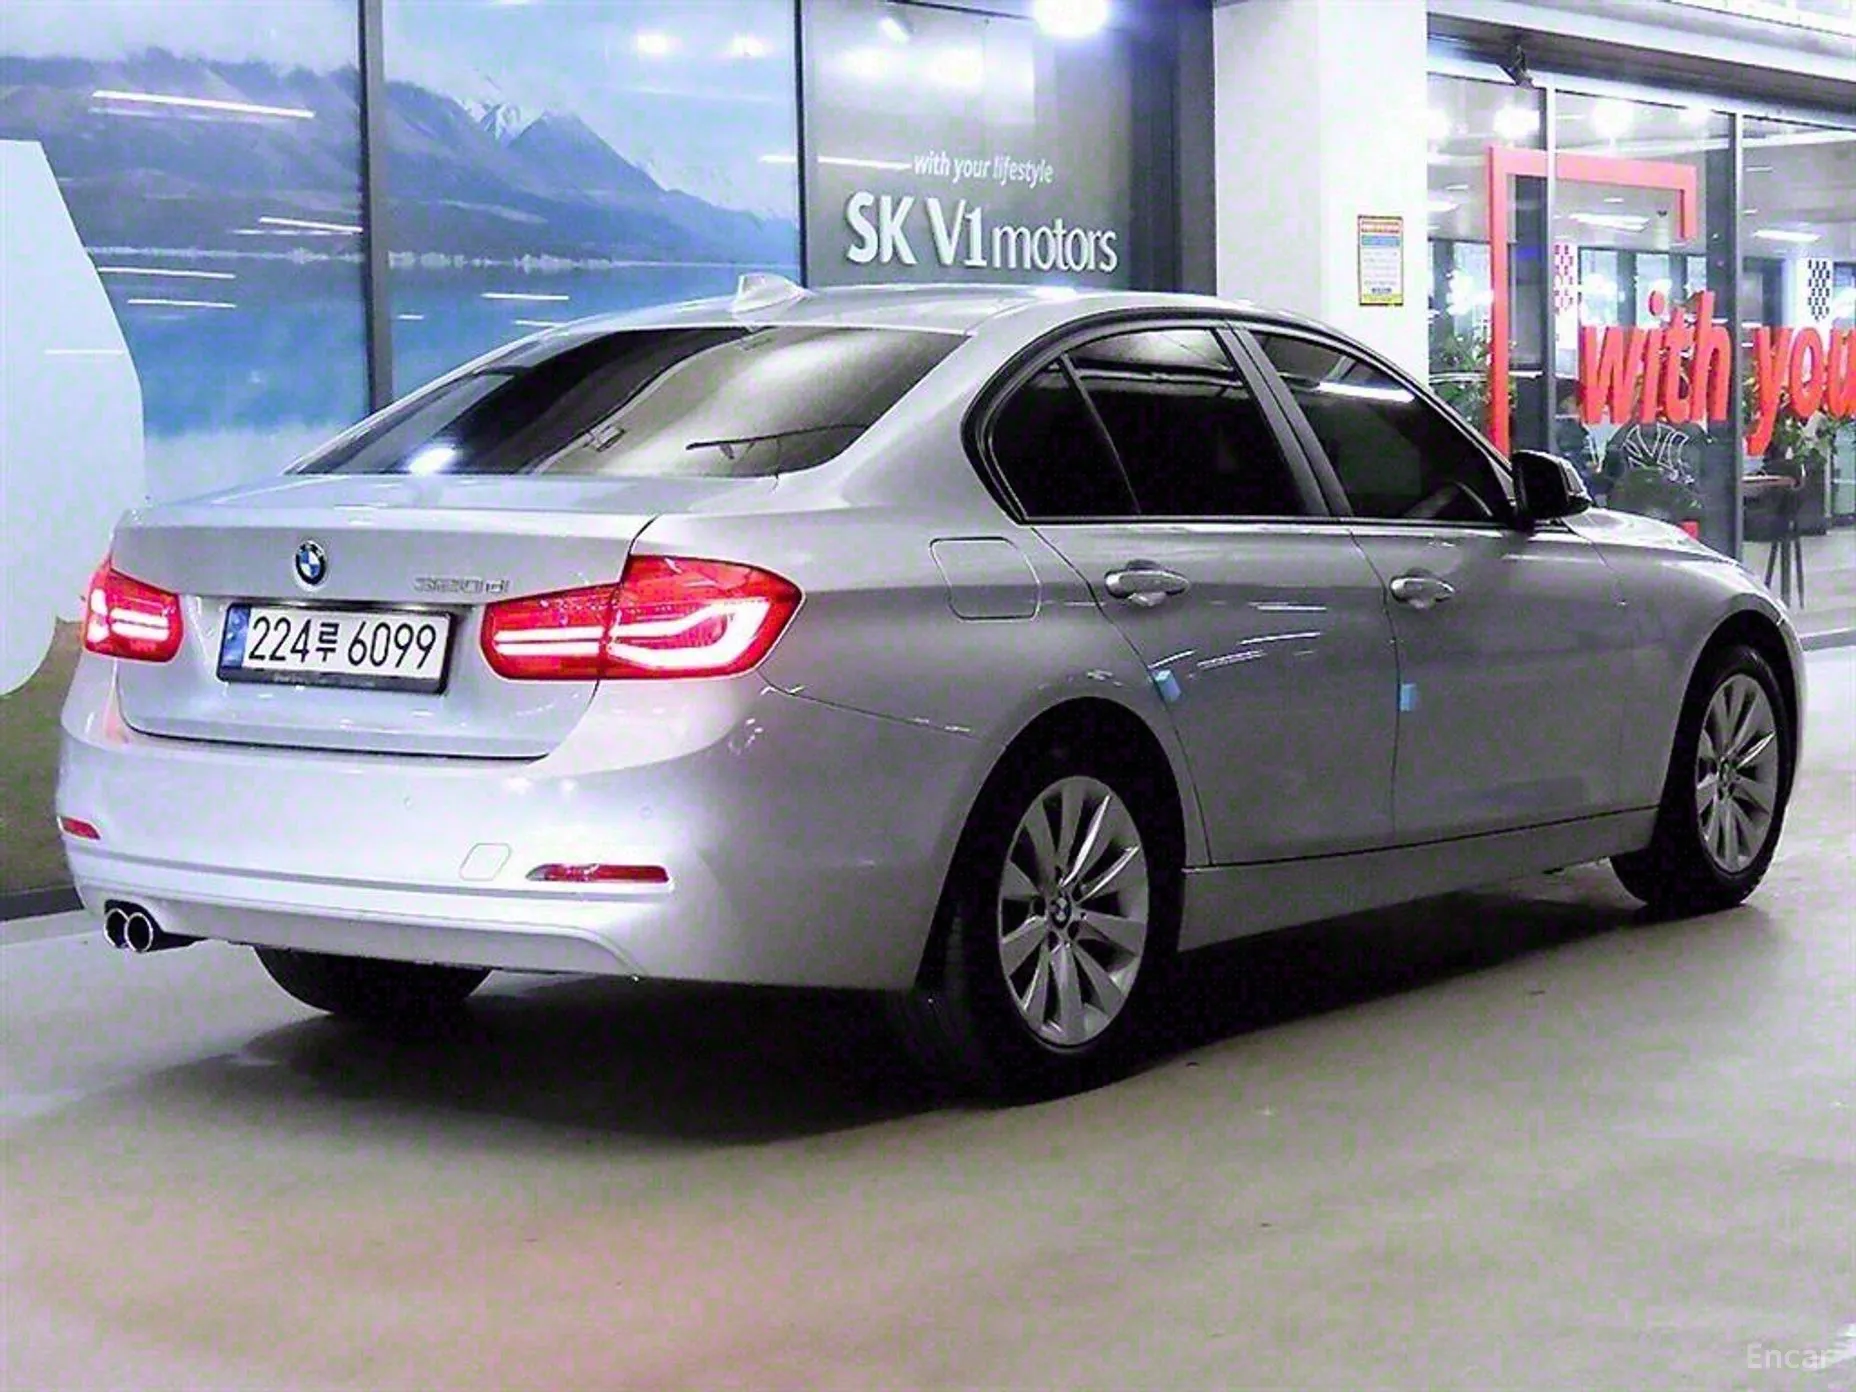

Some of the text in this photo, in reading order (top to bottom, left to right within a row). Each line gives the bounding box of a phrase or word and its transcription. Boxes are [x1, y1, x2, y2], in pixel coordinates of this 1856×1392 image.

[913, 151, 1054, 189] with your lifestyle
[845, 190, 918, 266] SK
[1579, 290, 1732, 425] with
[248, 615, 437, 670] 224루 6099
